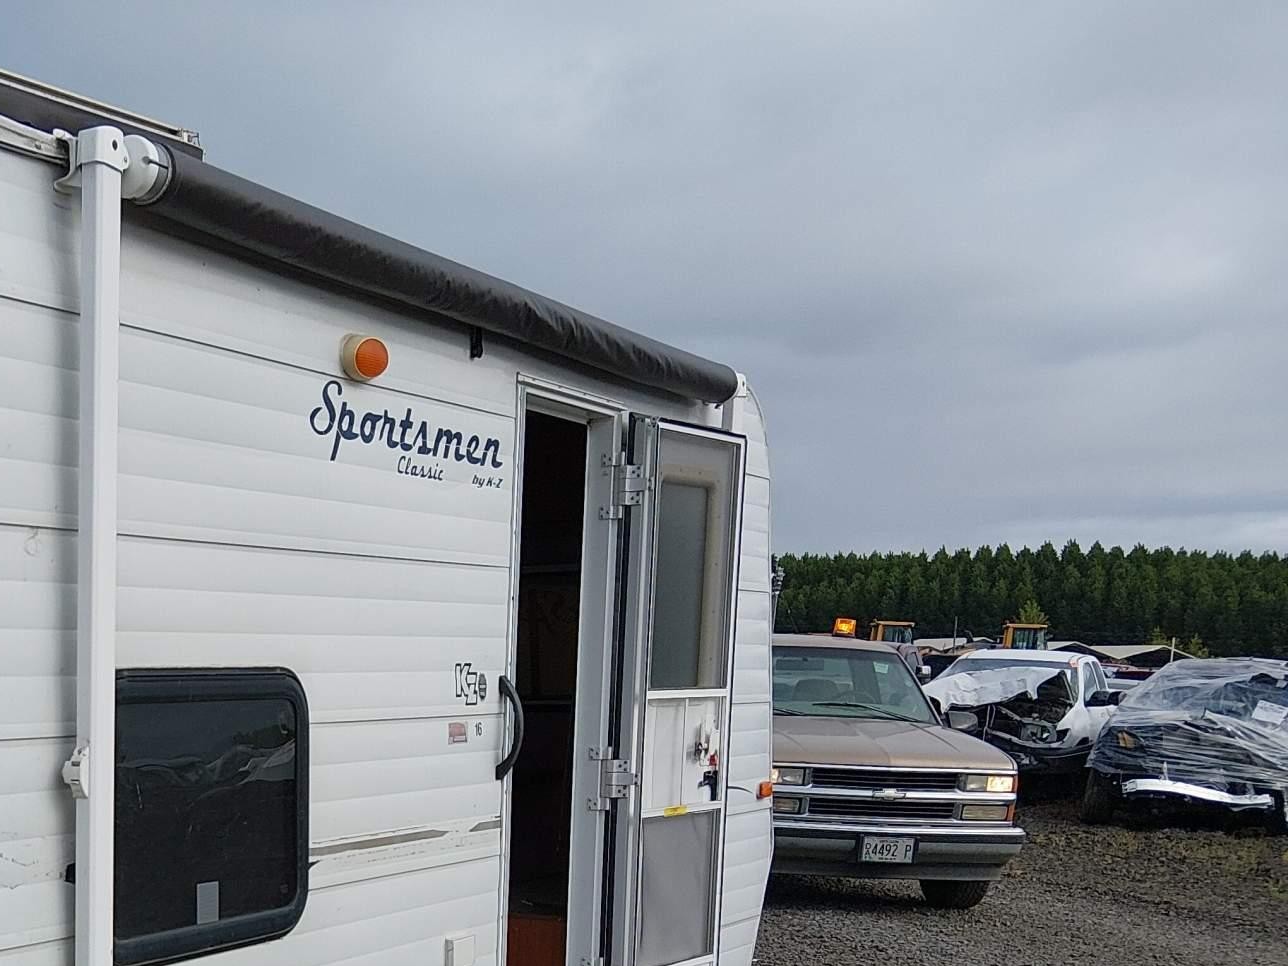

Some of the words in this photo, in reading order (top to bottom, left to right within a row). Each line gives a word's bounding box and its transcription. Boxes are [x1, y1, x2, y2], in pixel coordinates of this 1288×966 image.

[309, 380, 503, 468] Sportsmen
[397, 456, 444, 481] Classic
[472, 475, 484, 489] by
[486, 477, 503, 489] K-Z
[474, 721, 483, 737] 16
